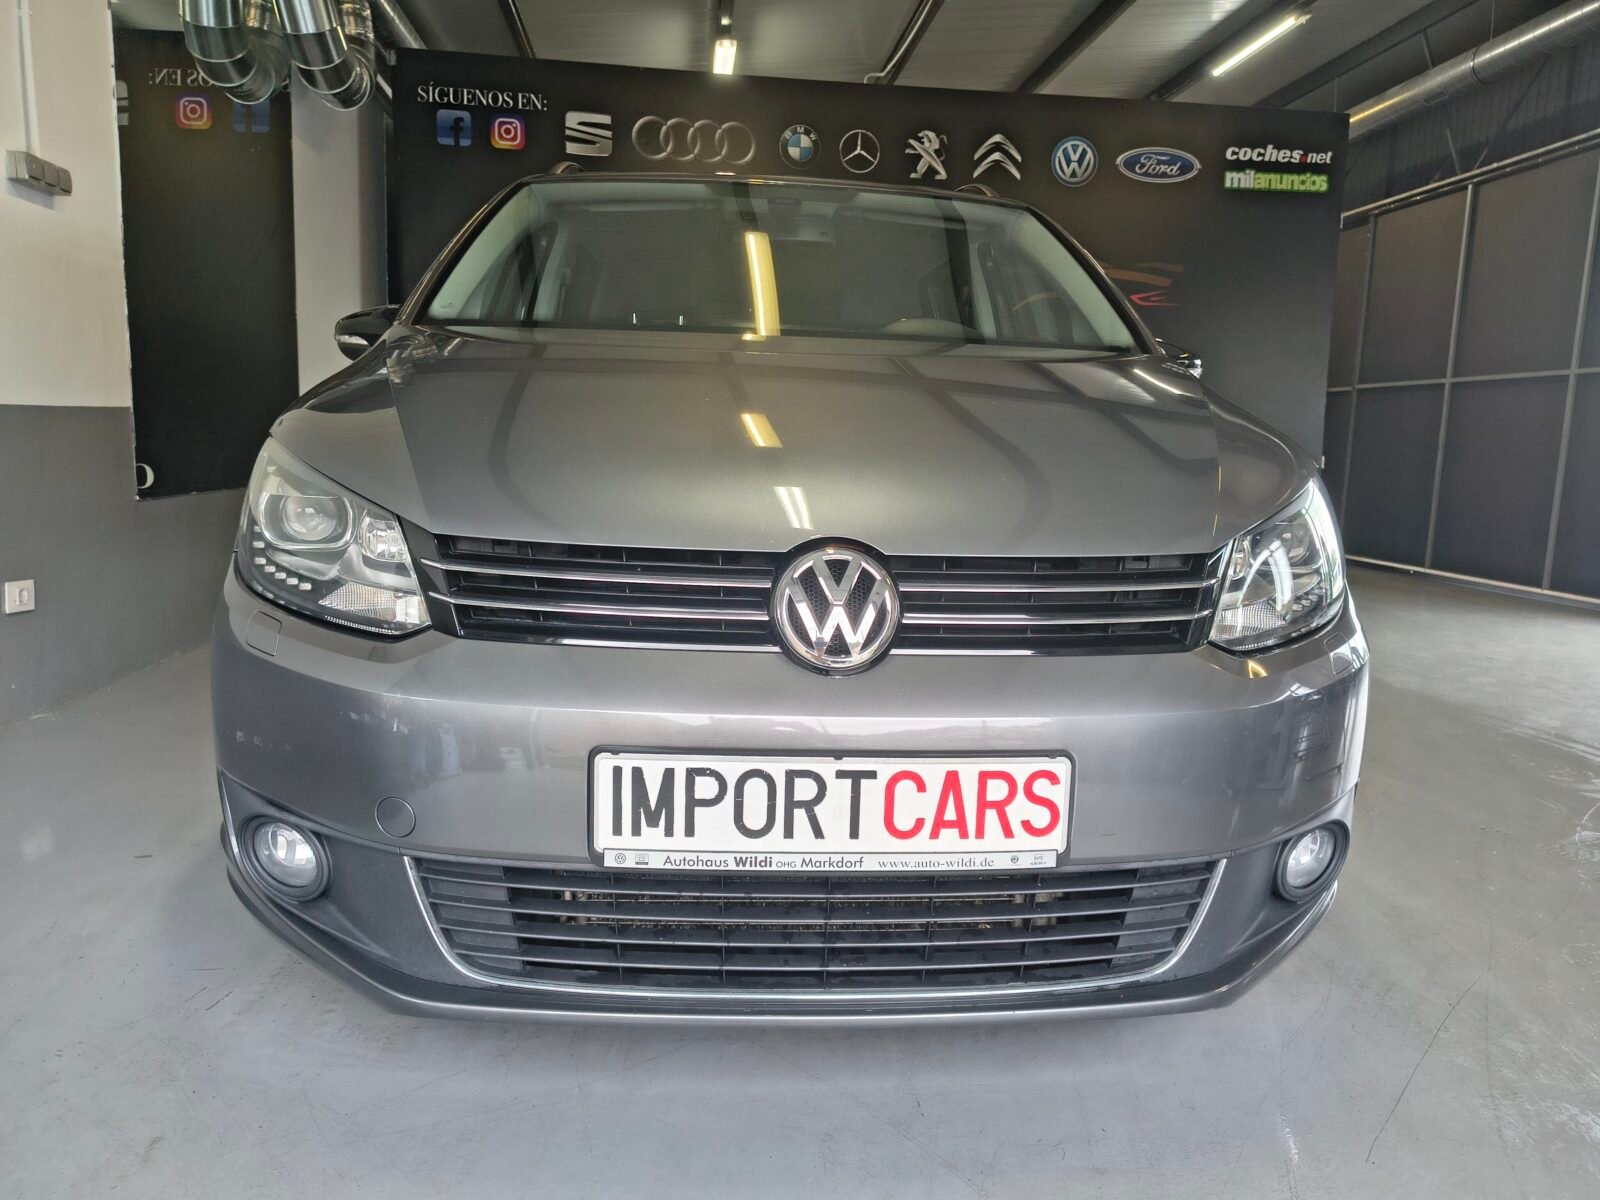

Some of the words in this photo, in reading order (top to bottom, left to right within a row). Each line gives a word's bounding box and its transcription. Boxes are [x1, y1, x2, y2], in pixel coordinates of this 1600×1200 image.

[417, 81, 513, 108] SÍGUENOS
[517, 92, 548, 111] EN:
[784, 126, 817, 140] BMW
[1225, 144, 1333, 164] coches.net
[1135, 154, 1181, 176] Ford
[1224, 169, 1328, 192] milanuncios
[663, 855, 729, 868] Autohaus
[733, 856, 773, 868] Wildi
[775, 860, 797, 869] OHG
[800, 856, 865, 869] Markdorf
[877, 857, 995, 869] www.auto-wildi.de
